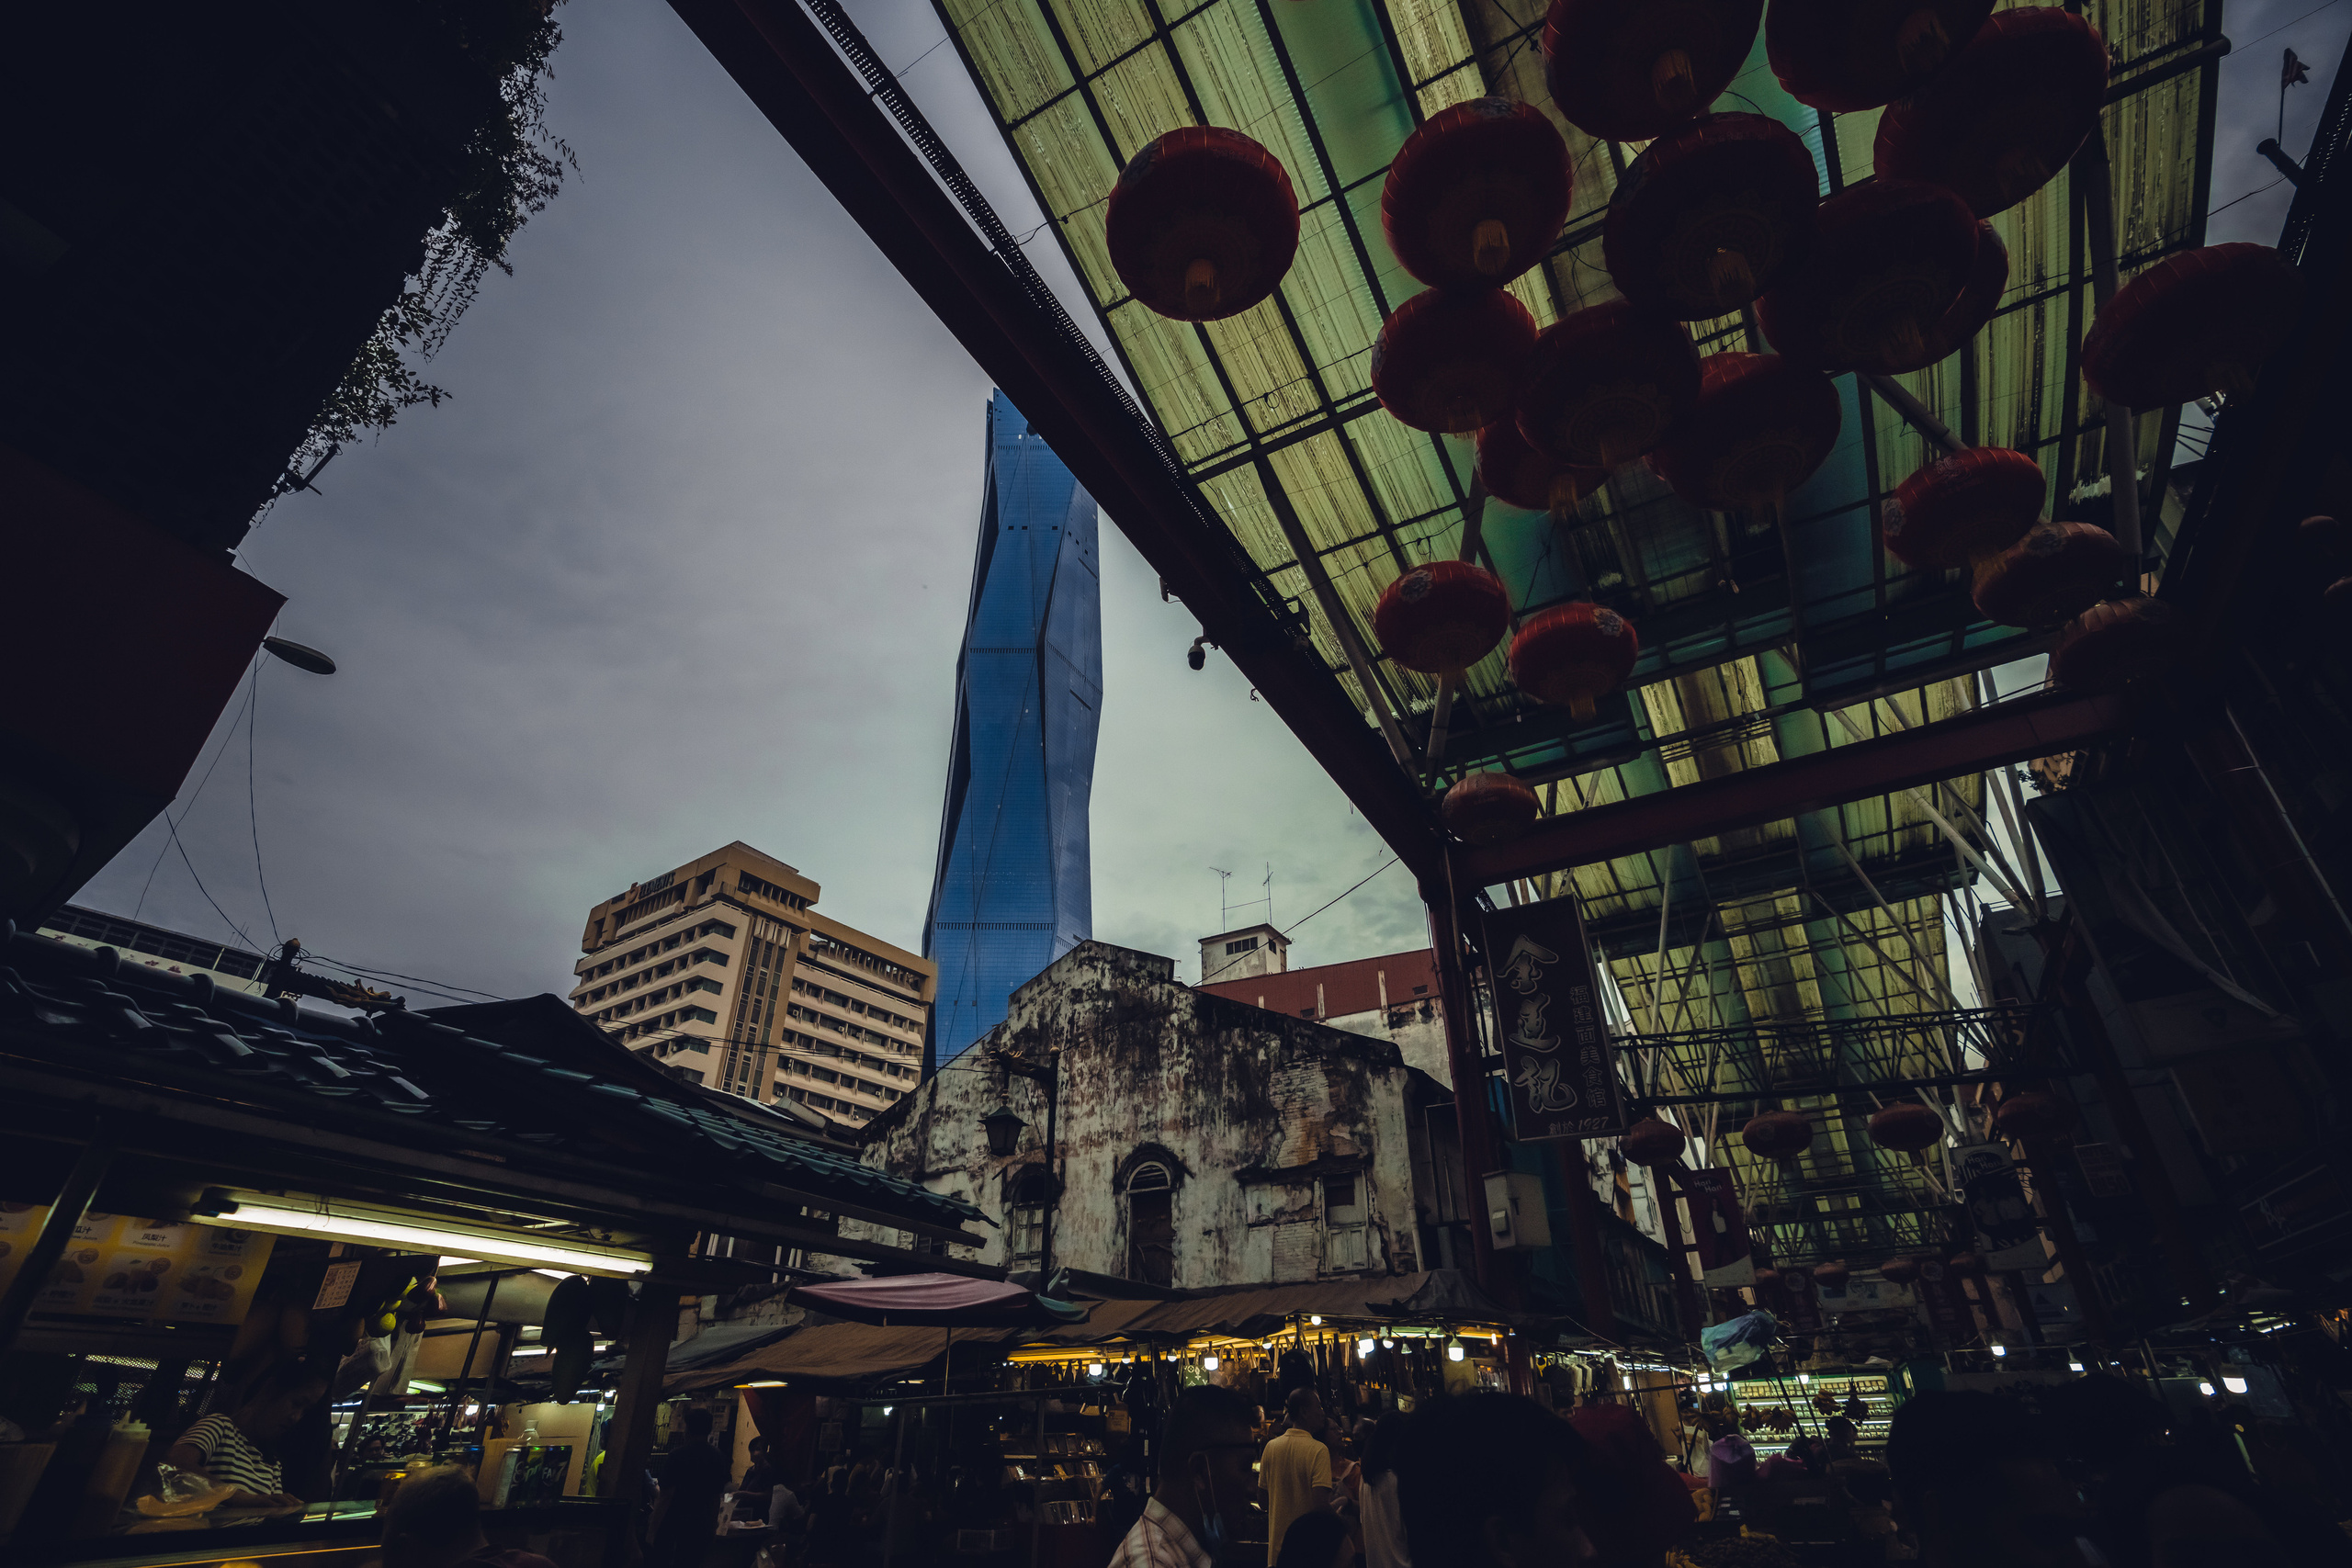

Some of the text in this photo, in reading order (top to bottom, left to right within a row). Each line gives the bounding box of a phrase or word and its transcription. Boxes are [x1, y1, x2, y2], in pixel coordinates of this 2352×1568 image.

[639, 872, 676, 899] ELEMENTS
[1578, 1116, 1609, 1132] 1927
[1693, 1178, 1712, 1189] Hari
[1704, 1183, 1723, 1194] Hari
